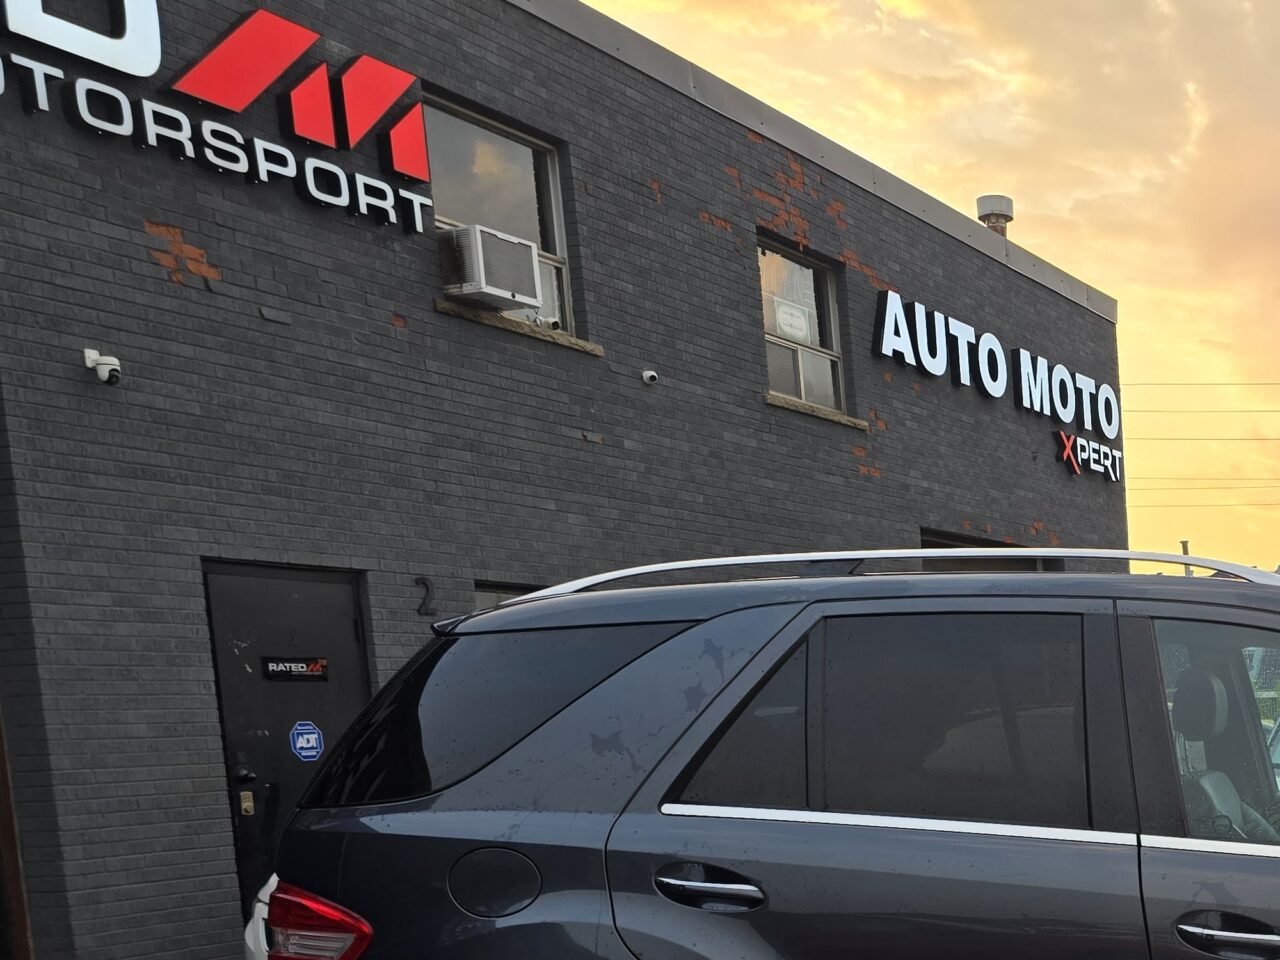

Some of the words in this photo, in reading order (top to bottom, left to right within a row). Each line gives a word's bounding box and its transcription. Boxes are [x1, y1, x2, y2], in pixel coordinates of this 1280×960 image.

[0, 53, 433, 233] TORSPORT
[881, 289, 1007, 398] AUTO
[1020, 348, 1120, 440] MOTO
[1060, 430, 1122, 481] XPERT
[415, 577, 437, 616] 2
[268, 663, 307, 672] RATED
[297, 734, 317, 748] ADT
